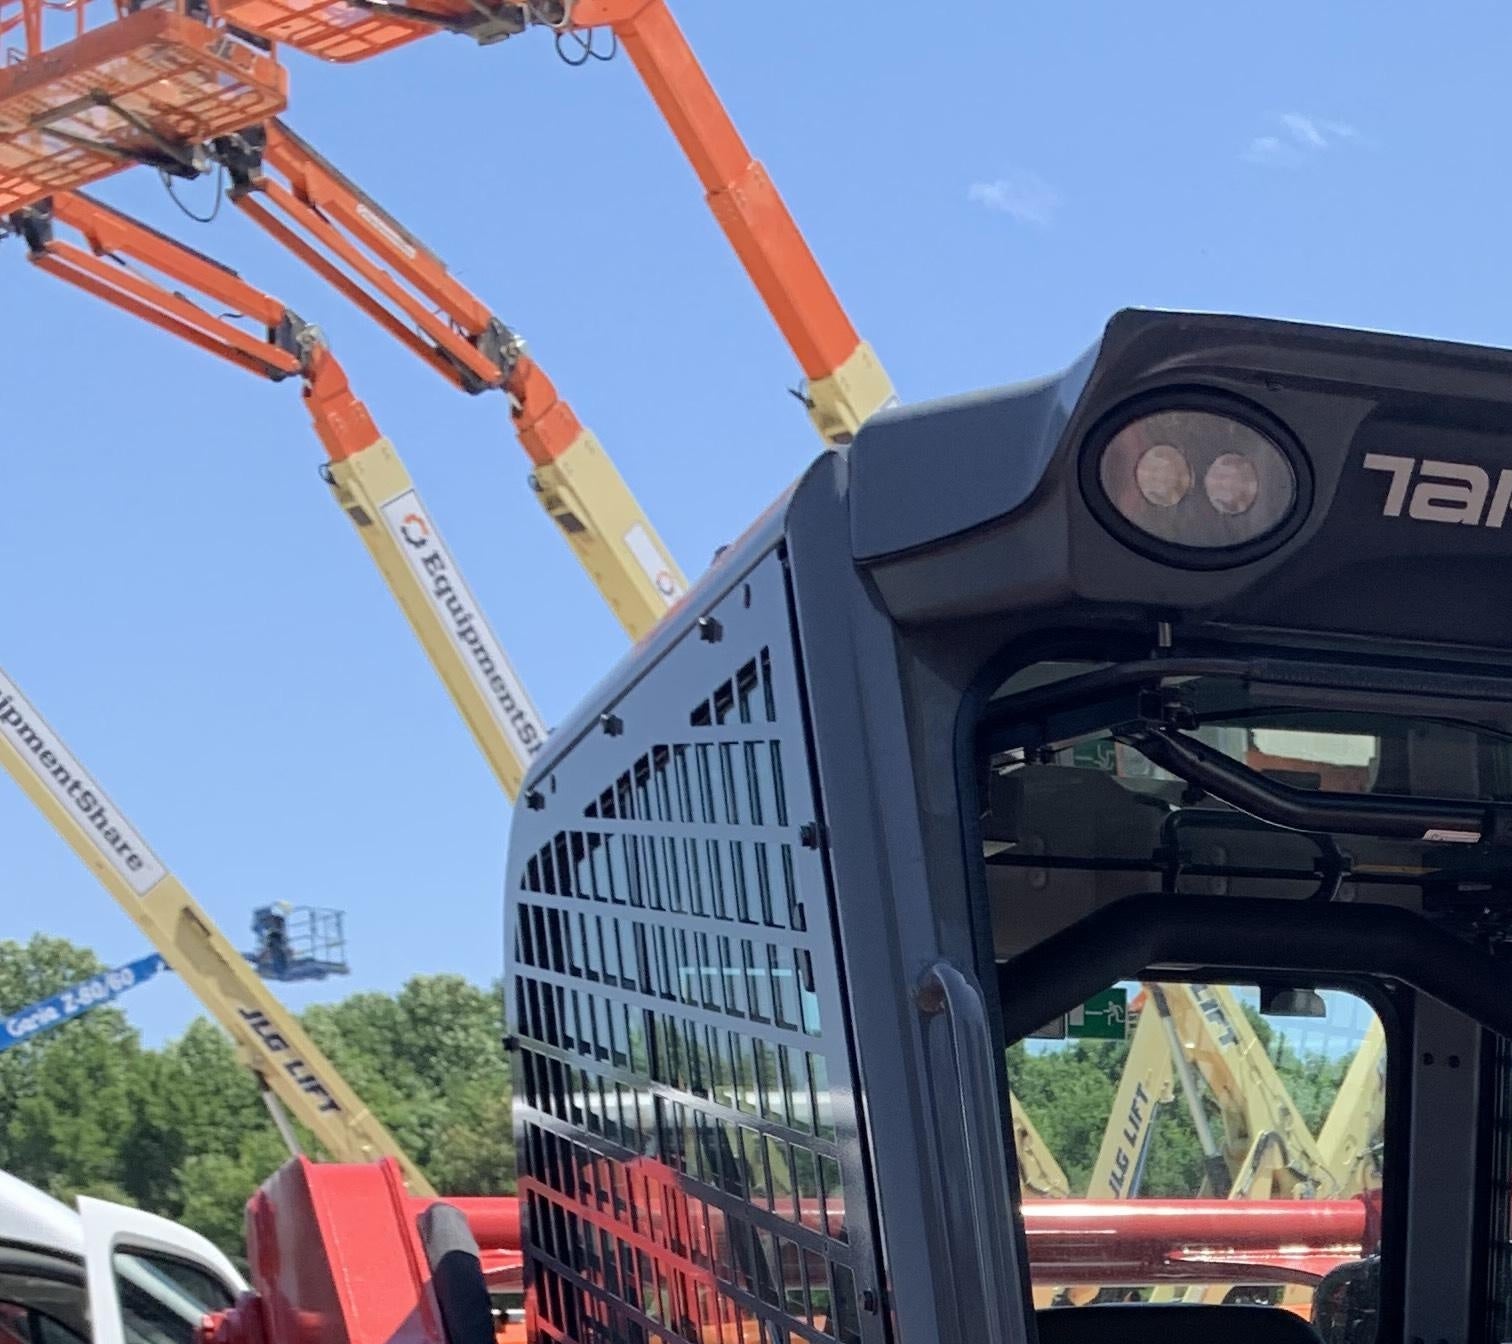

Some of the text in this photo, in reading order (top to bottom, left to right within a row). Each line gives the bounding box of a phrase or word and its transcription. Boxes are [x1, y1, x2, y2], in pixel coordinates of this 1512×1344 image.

[0, 690, 144, 872] ipmentShare
[237, 1008, 342, 1112] JLG LIFT
[1122, 1081, 1149, 1148] LIFT
